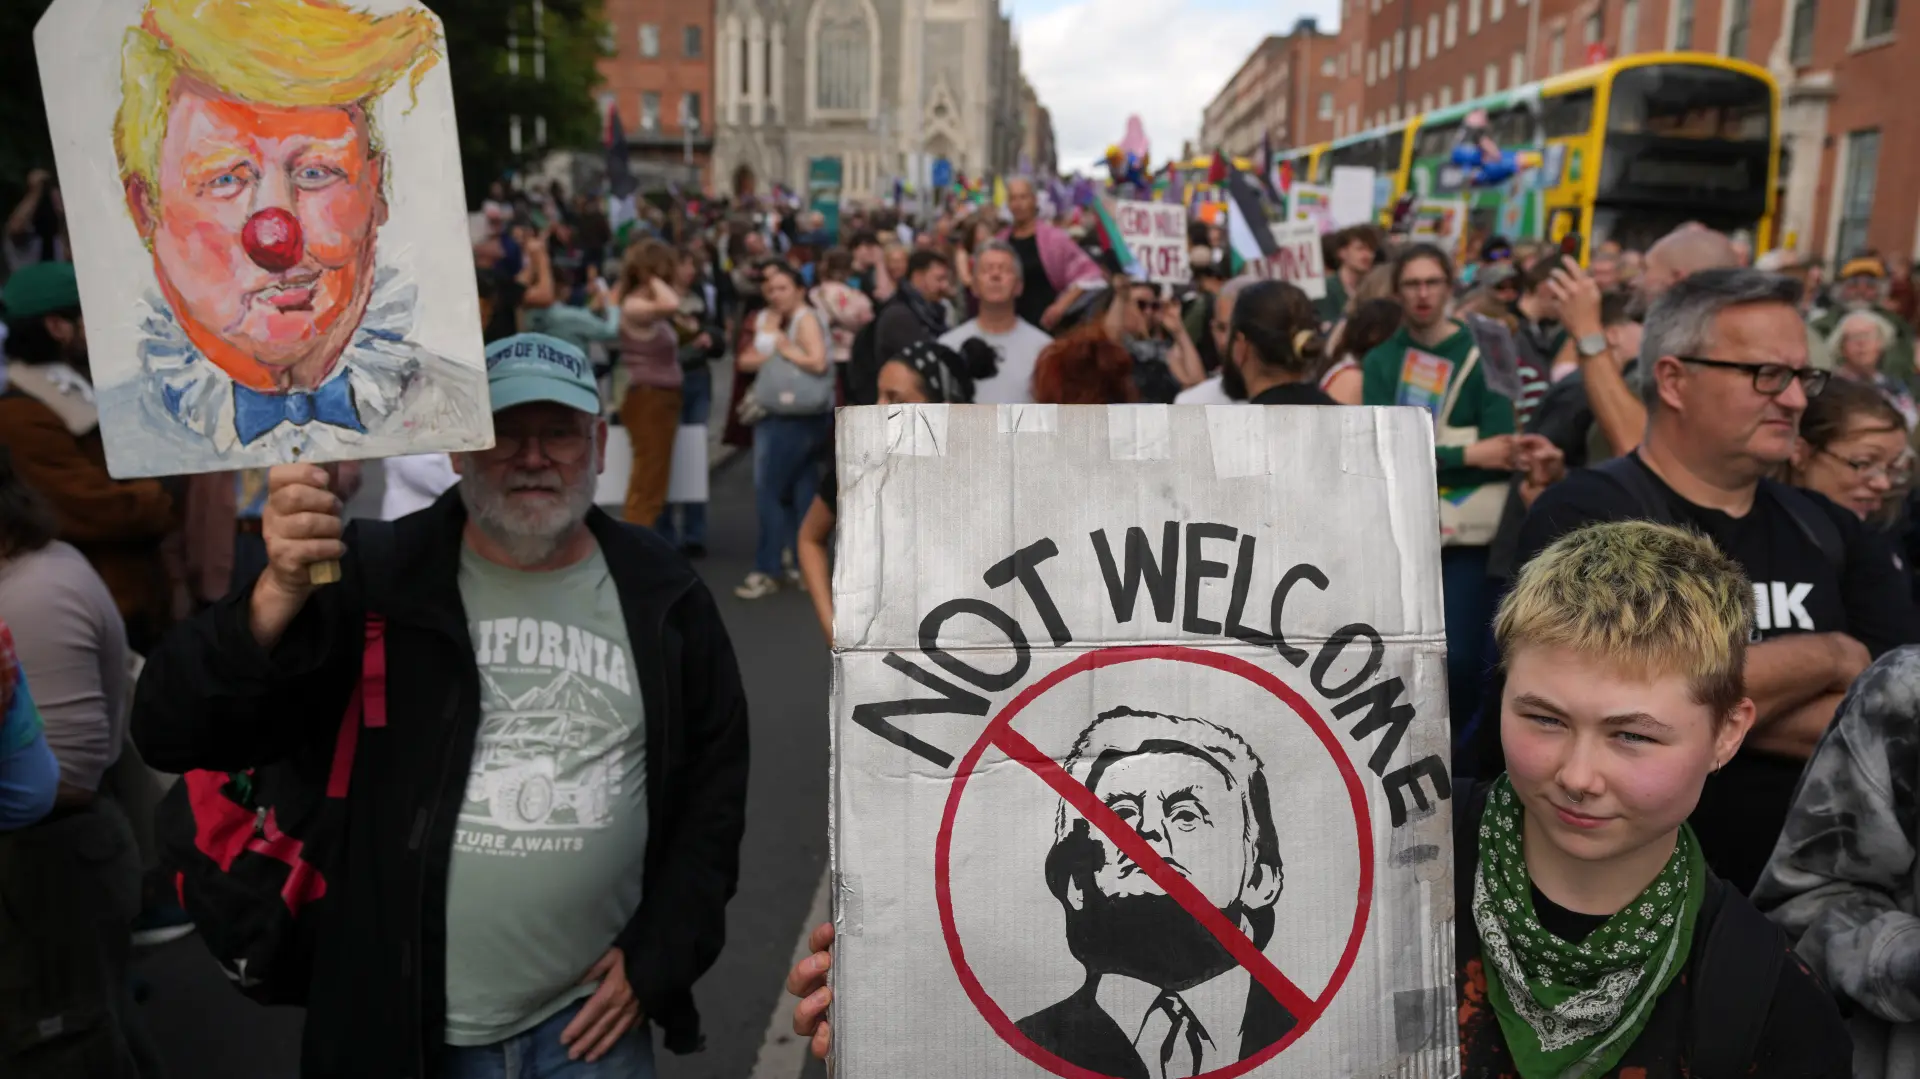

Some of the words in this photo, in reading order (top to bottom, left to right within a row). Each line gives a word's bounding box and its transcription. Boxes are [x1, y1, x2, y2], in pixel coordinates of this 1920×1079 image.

[515, 341, 534, 358] OF
[537, 343, 582, 379] KERRY
[470, 616, 631, 696] IFORNIA
[851, 536, 1075, 769] NOT
[1089, 520, 1452, 828] WELCOME
[511, 836, 585, 853] AWAITS
